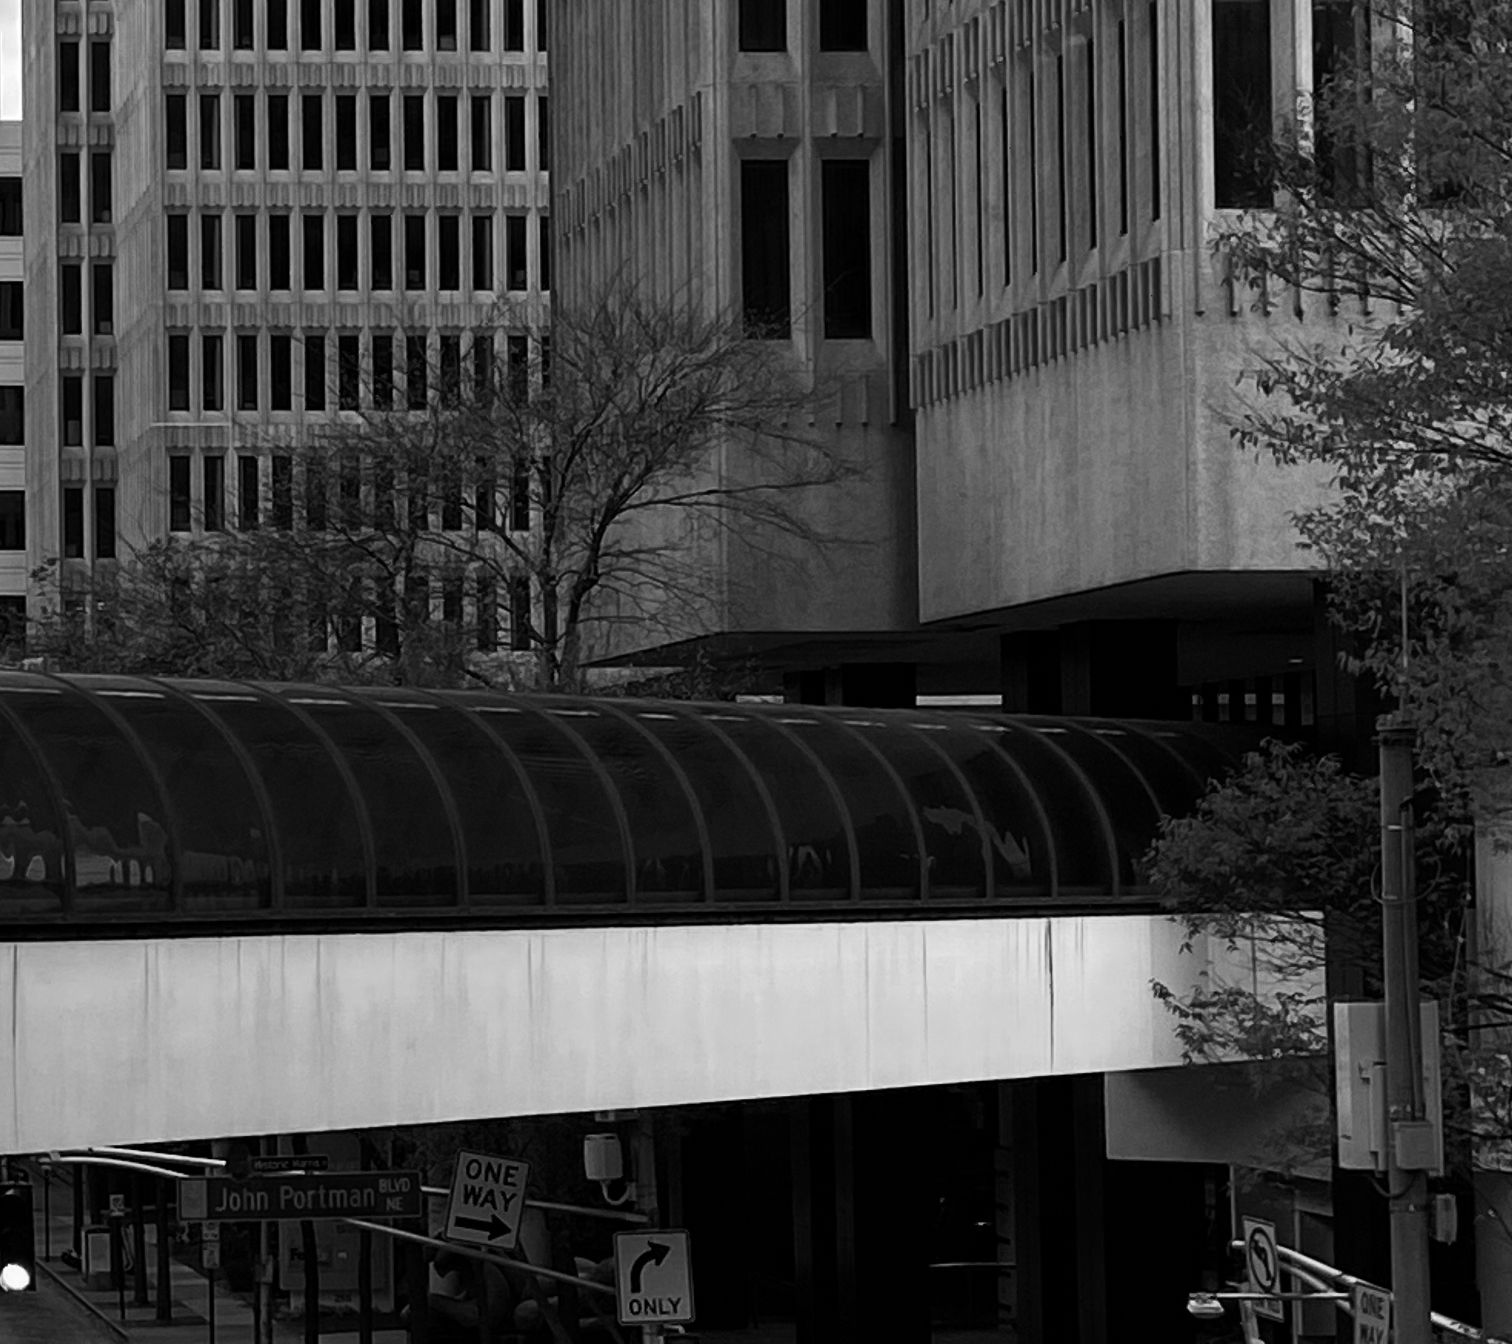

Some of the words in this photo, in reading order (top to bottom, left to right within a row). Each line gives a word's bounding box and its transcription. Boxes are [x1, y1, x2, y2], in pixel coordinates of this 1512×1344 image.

[466, 1158, 519, 1187] ONE
[215, 1186, 269, 1212] John
[280, 1184, 375, 1210] Portman
[378, 1177, 411, 1193] BLVD
[386, 1196, 404, 1211] NE
[463, 1183, 517, 1212] WAY
[628, 1296, 682, 1316] ONLY
[1360, 1291, 1385, 1320] ONE
